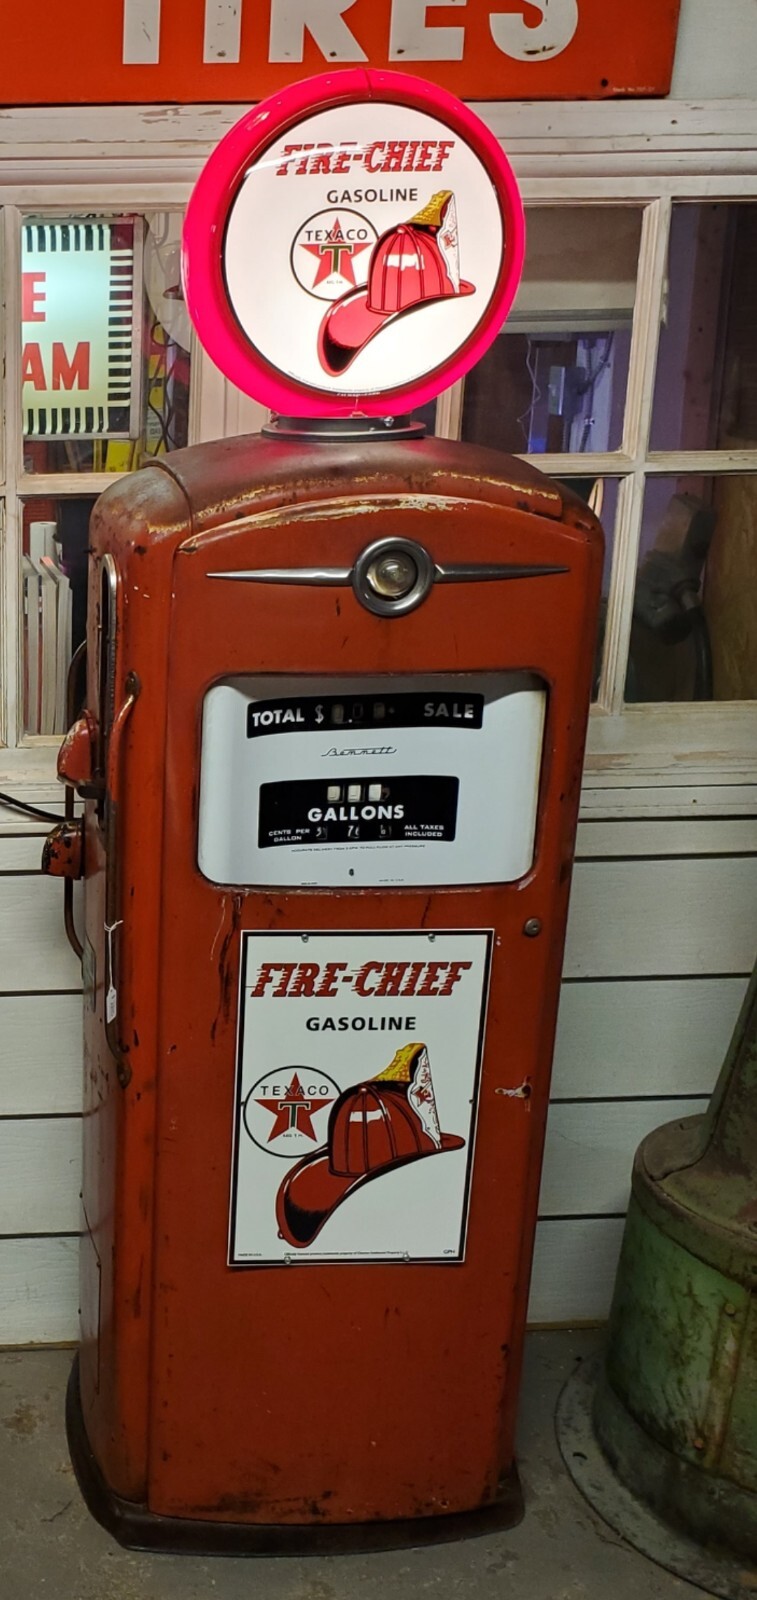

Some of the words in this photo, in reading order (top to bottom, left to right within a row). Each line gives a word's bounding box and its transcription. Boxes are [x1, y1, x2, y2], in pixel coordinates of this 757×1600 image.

[275, 140, 455, 176] FIRE-CHIEF
[326, 187, 418, 204] GASOLINE
[305, 228, 368, 242] TEXACO
[22, 272, 46, 322] E
[252, 708, 305, 727] TOTAL
[424, 702, 475, 719] SALE
[320, 746, 398, 757] Bennett
[307, 804, 405, 822] GALLONS
[273, 835, 302, 843] GALLON
[249, 961, 473, 998] FIRE-CHIEF
[305, 1016, 417, 1032] GASOLINE
[260, 1085, 329, 1097] TEXACO
